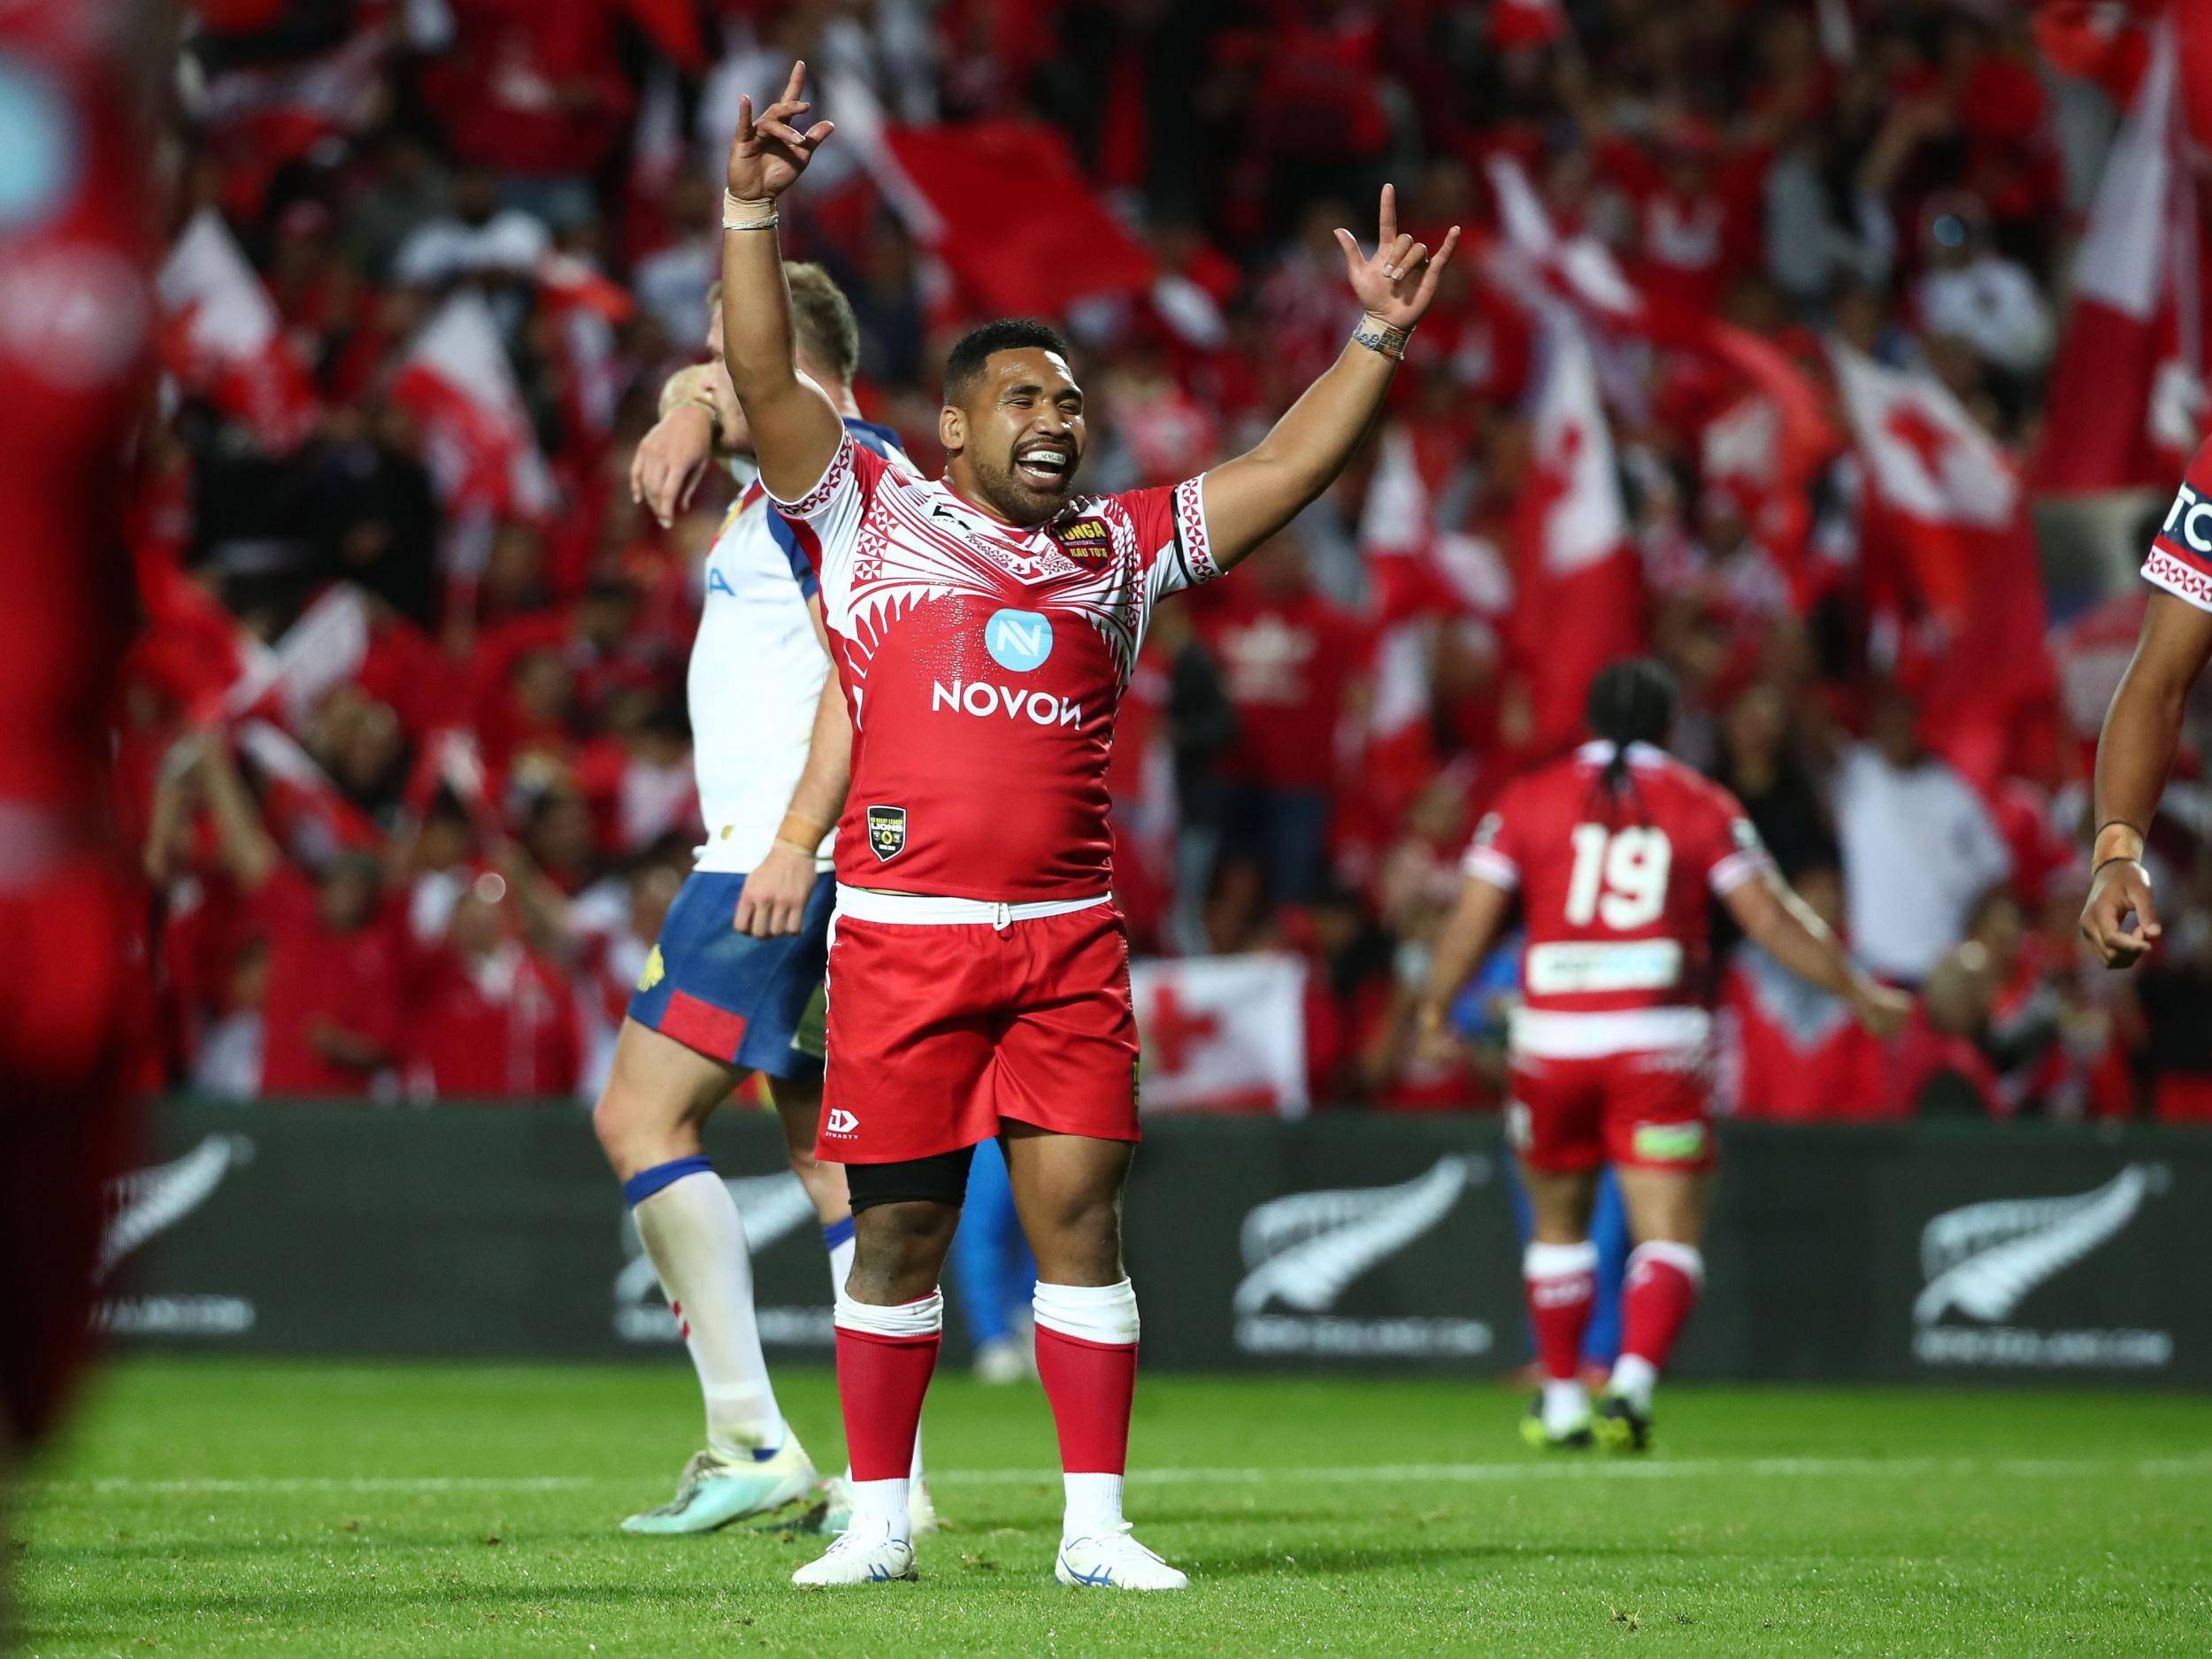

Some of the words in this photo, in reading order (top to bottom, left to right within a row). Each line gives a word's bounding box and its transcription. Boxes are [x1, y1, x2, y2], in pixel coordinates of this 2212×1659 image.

[1070, 548, 1089, 557] KAU
[871, 822, 903, 833] LIONS
[1564, 822, 1672, 931] 19
